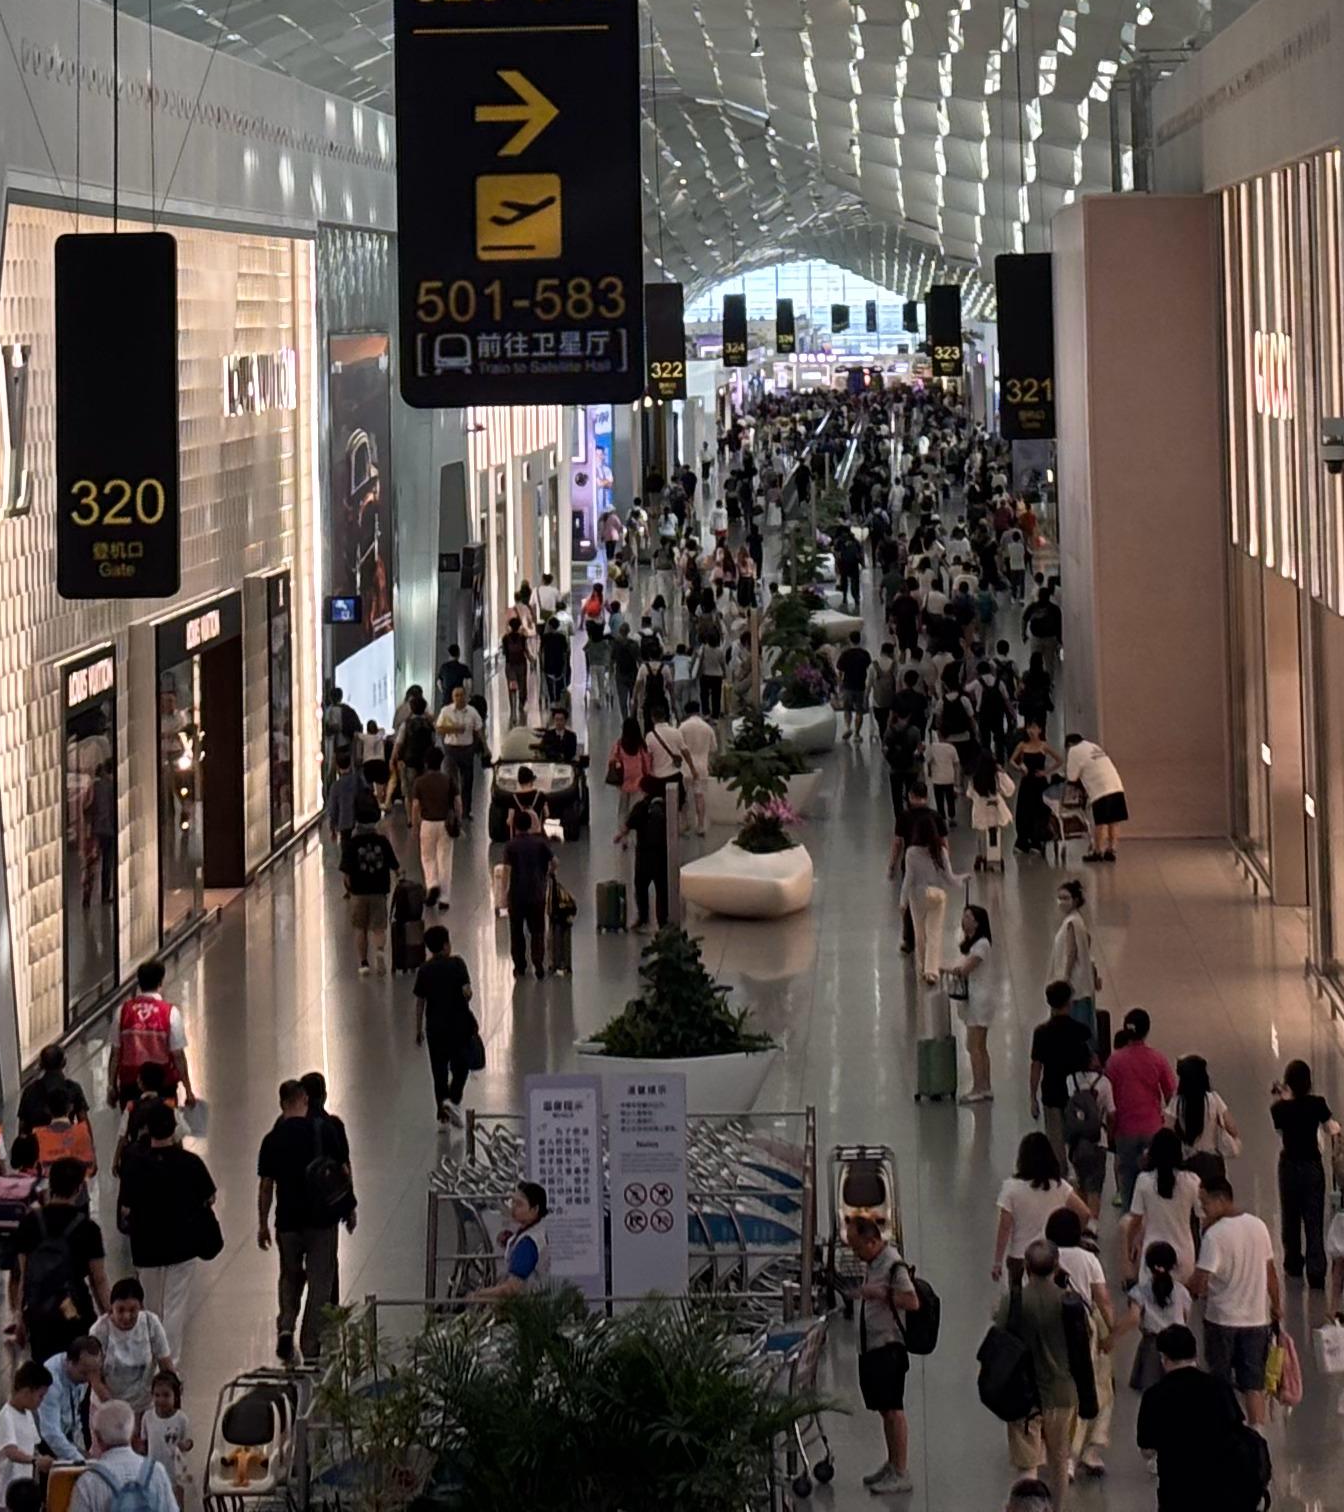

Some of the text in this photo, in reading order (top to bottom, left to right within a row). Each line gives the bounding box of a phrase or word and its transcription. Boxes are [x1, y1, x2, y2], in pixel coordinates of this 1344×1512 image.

[416, 276, 626, 322] 501-583
[477, 330, 610, 358] 前往卫星厅
[934, 346, 960, 359] 323
[650, 361, 683, 378] 322
[1006, 377, 1053, 403] 321
[71, 479, 165, 525] 320
